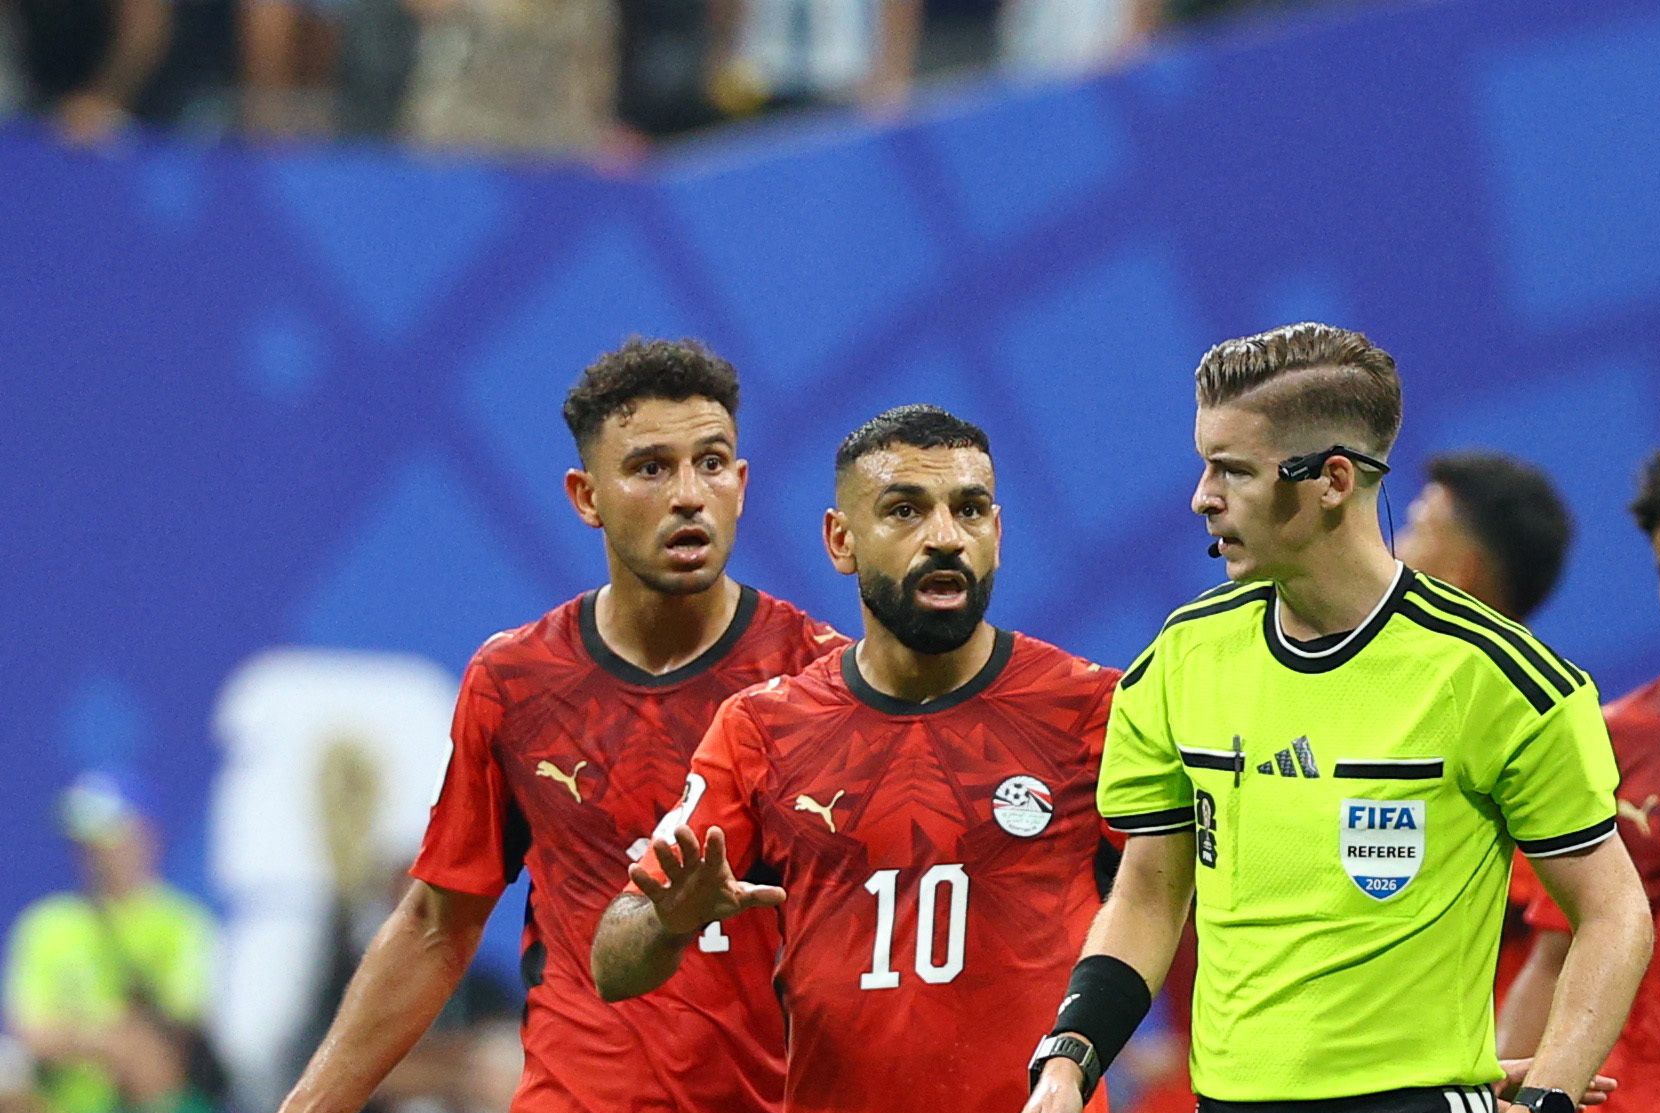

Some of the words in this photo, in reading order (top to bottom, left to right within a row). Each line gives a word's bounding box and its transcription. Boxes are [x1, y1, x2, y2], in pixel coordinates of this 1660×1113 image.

[1348, 805, 1417, 830] FIFA
[1347, 845, 1416, 858] REFEREE
[1365, 878, 1397, 890] 2026
[859, 862, 970, 991] 10
